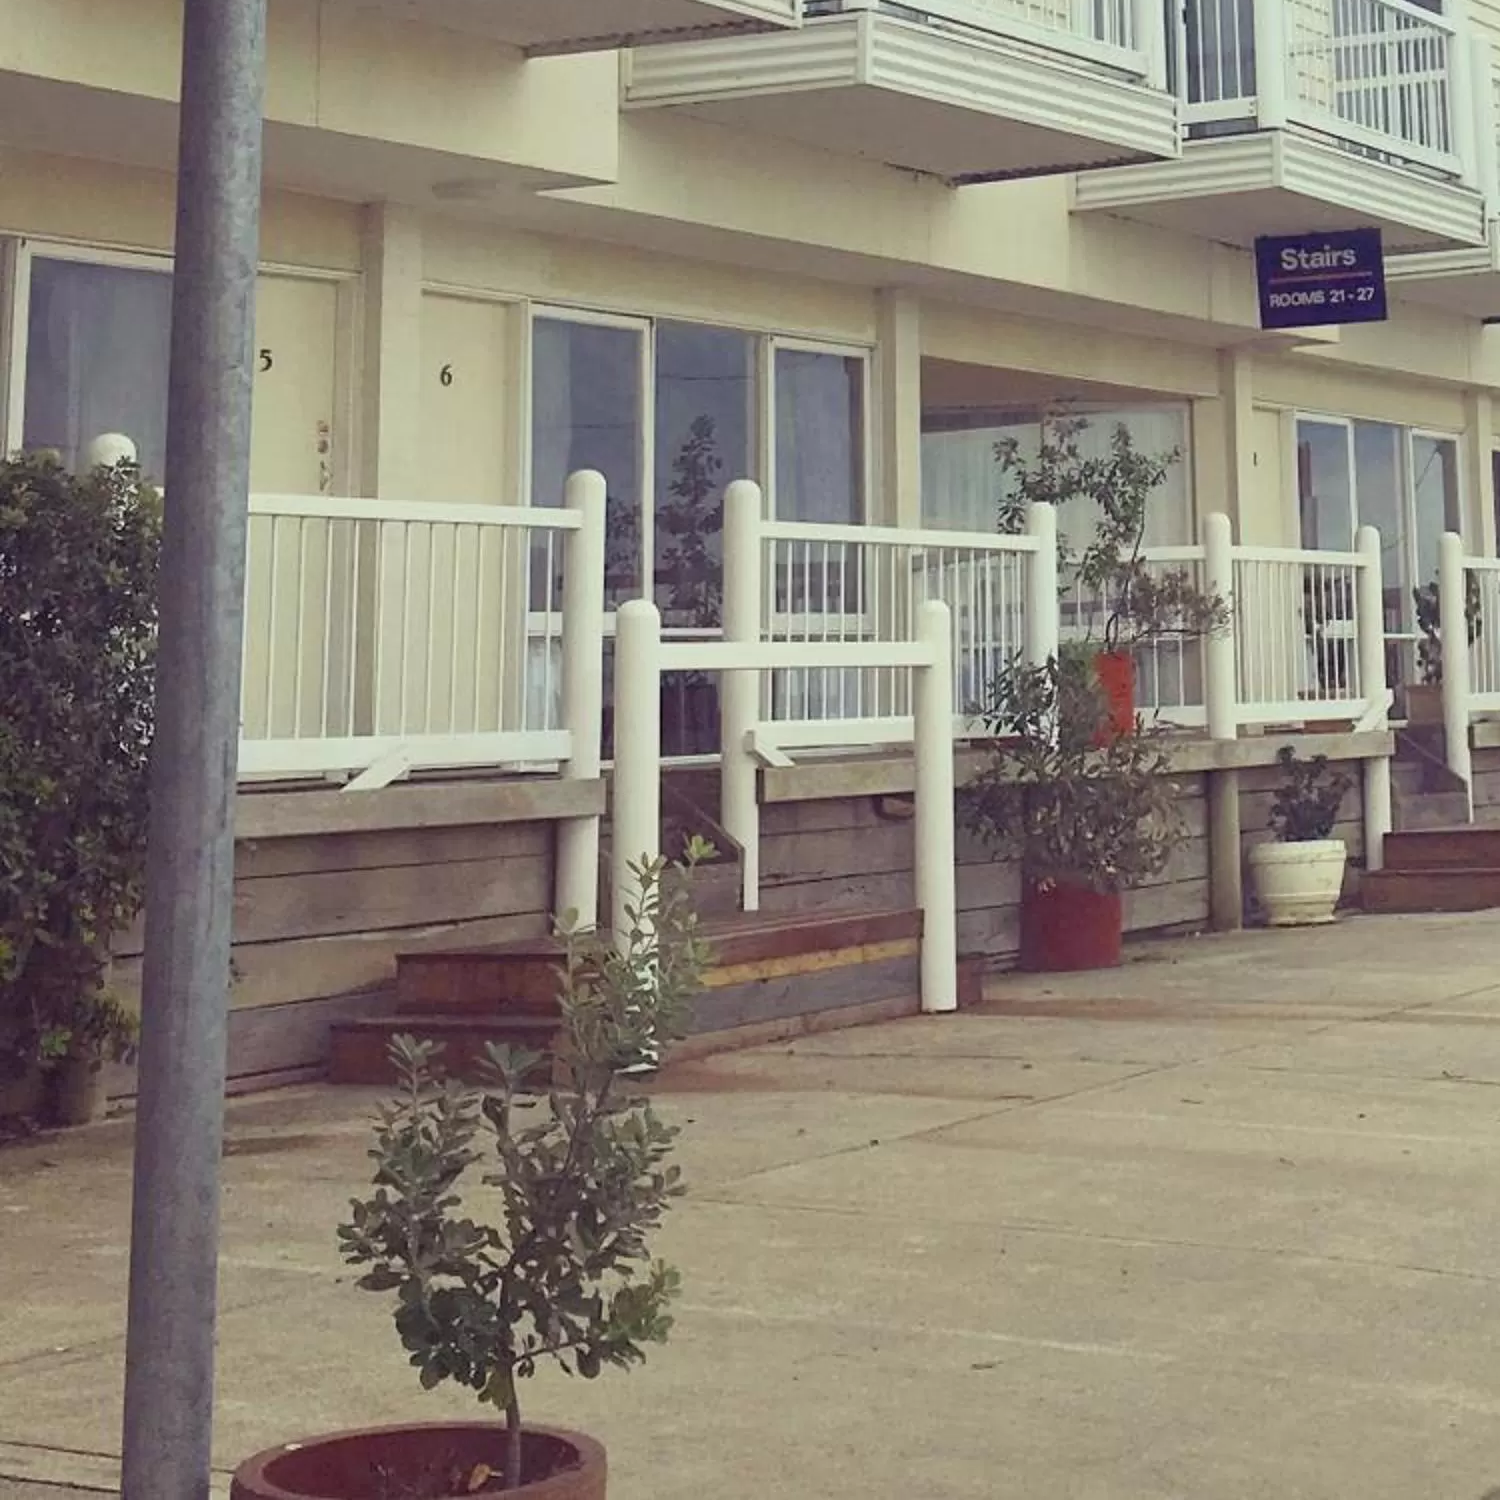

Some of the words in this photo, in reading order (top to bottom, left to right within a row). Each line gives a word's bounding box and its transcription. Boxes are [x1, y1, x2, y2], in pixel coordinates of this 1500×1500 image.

[1280, 244, 1357, 270] Stairs
[1269, 290, 1325, 308] ROOMS
[1329, 289, 1345, 303] 21
[1356, 287, 1375, 301] 27
[259, 349, 273, 372] 5
[440, 364, 453, 386] 6
